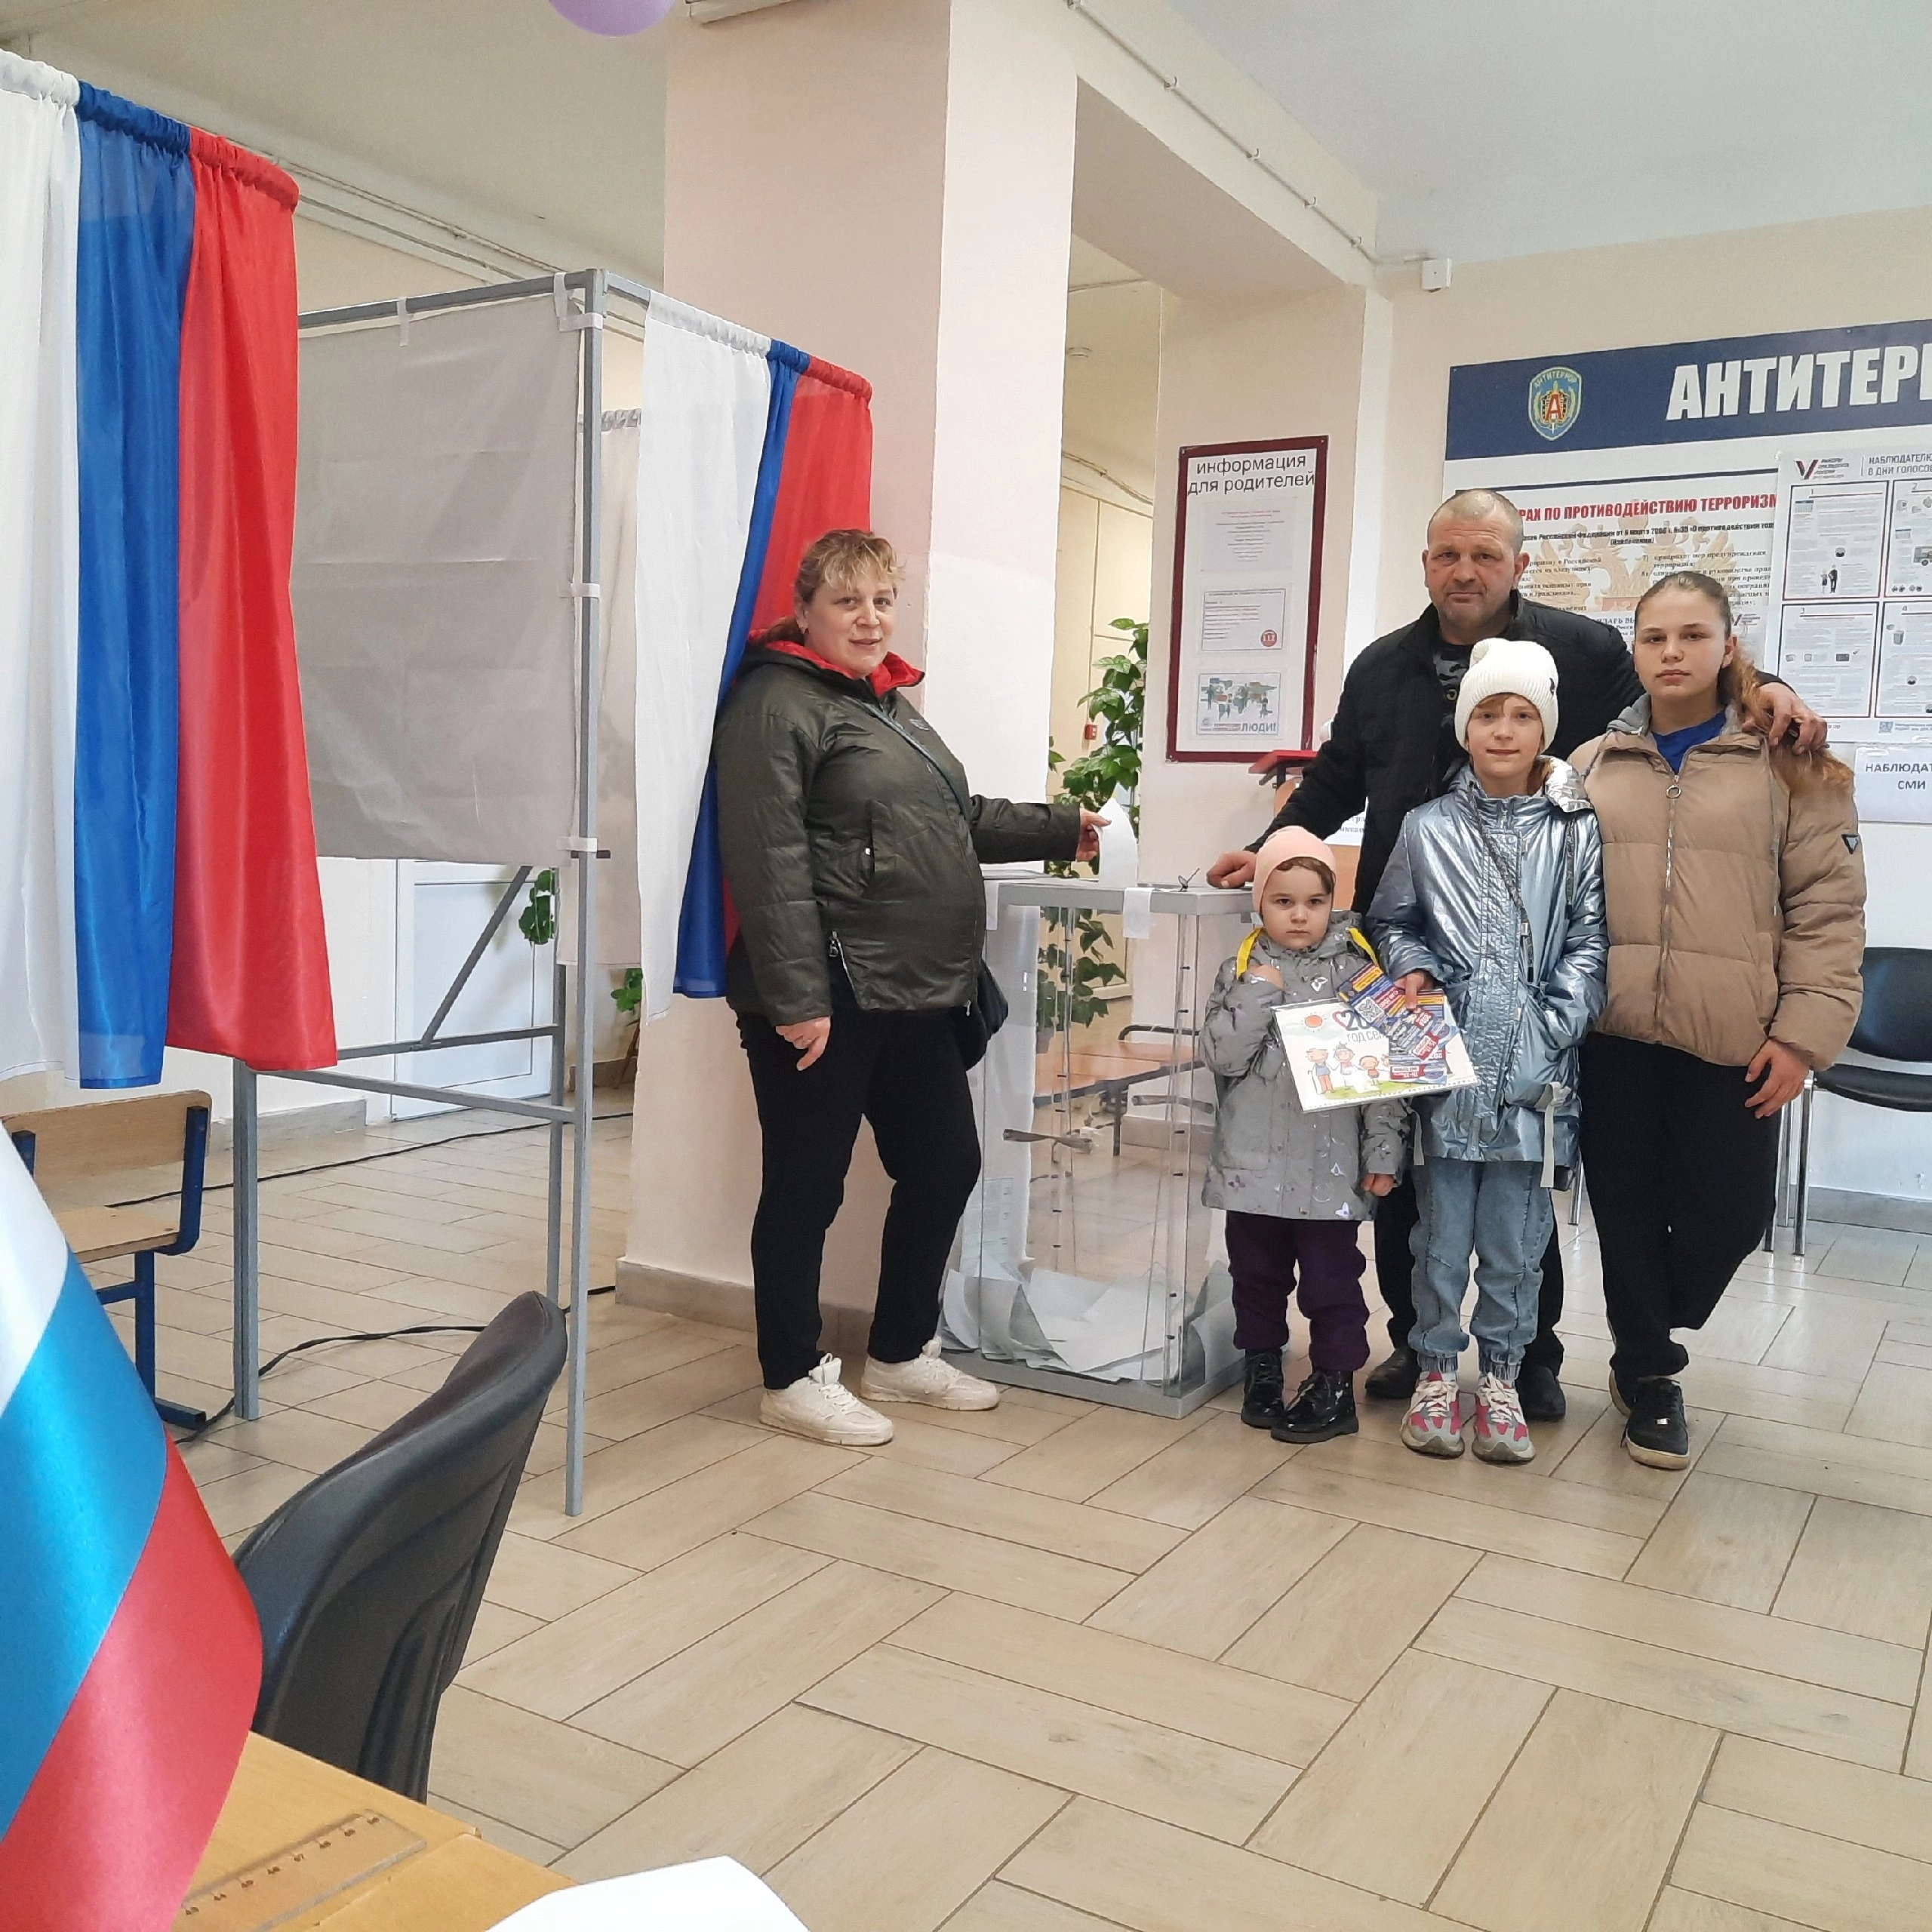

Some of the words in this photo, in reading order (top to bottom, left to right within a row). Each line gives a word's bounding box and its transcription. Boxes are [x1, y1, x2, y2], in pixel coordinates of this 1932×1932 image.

[1197, 455, 1306, 476] информация
[1875, 466, 1894, 476] ДНИ
[1188, 481, 1219, 496] для
[1224, 471, 1315, 494] родителей
[1544, 507, 1561, 521] ПО
[1564, 498, 1697, 520] ПРОТИВОДЕЙСТВИЮ
[1241, 722, 1276, 733] ЛЮДИ!
[1897, 780, 1926, 789] СМИ
[1346, 1032, 1367, 1043] год
